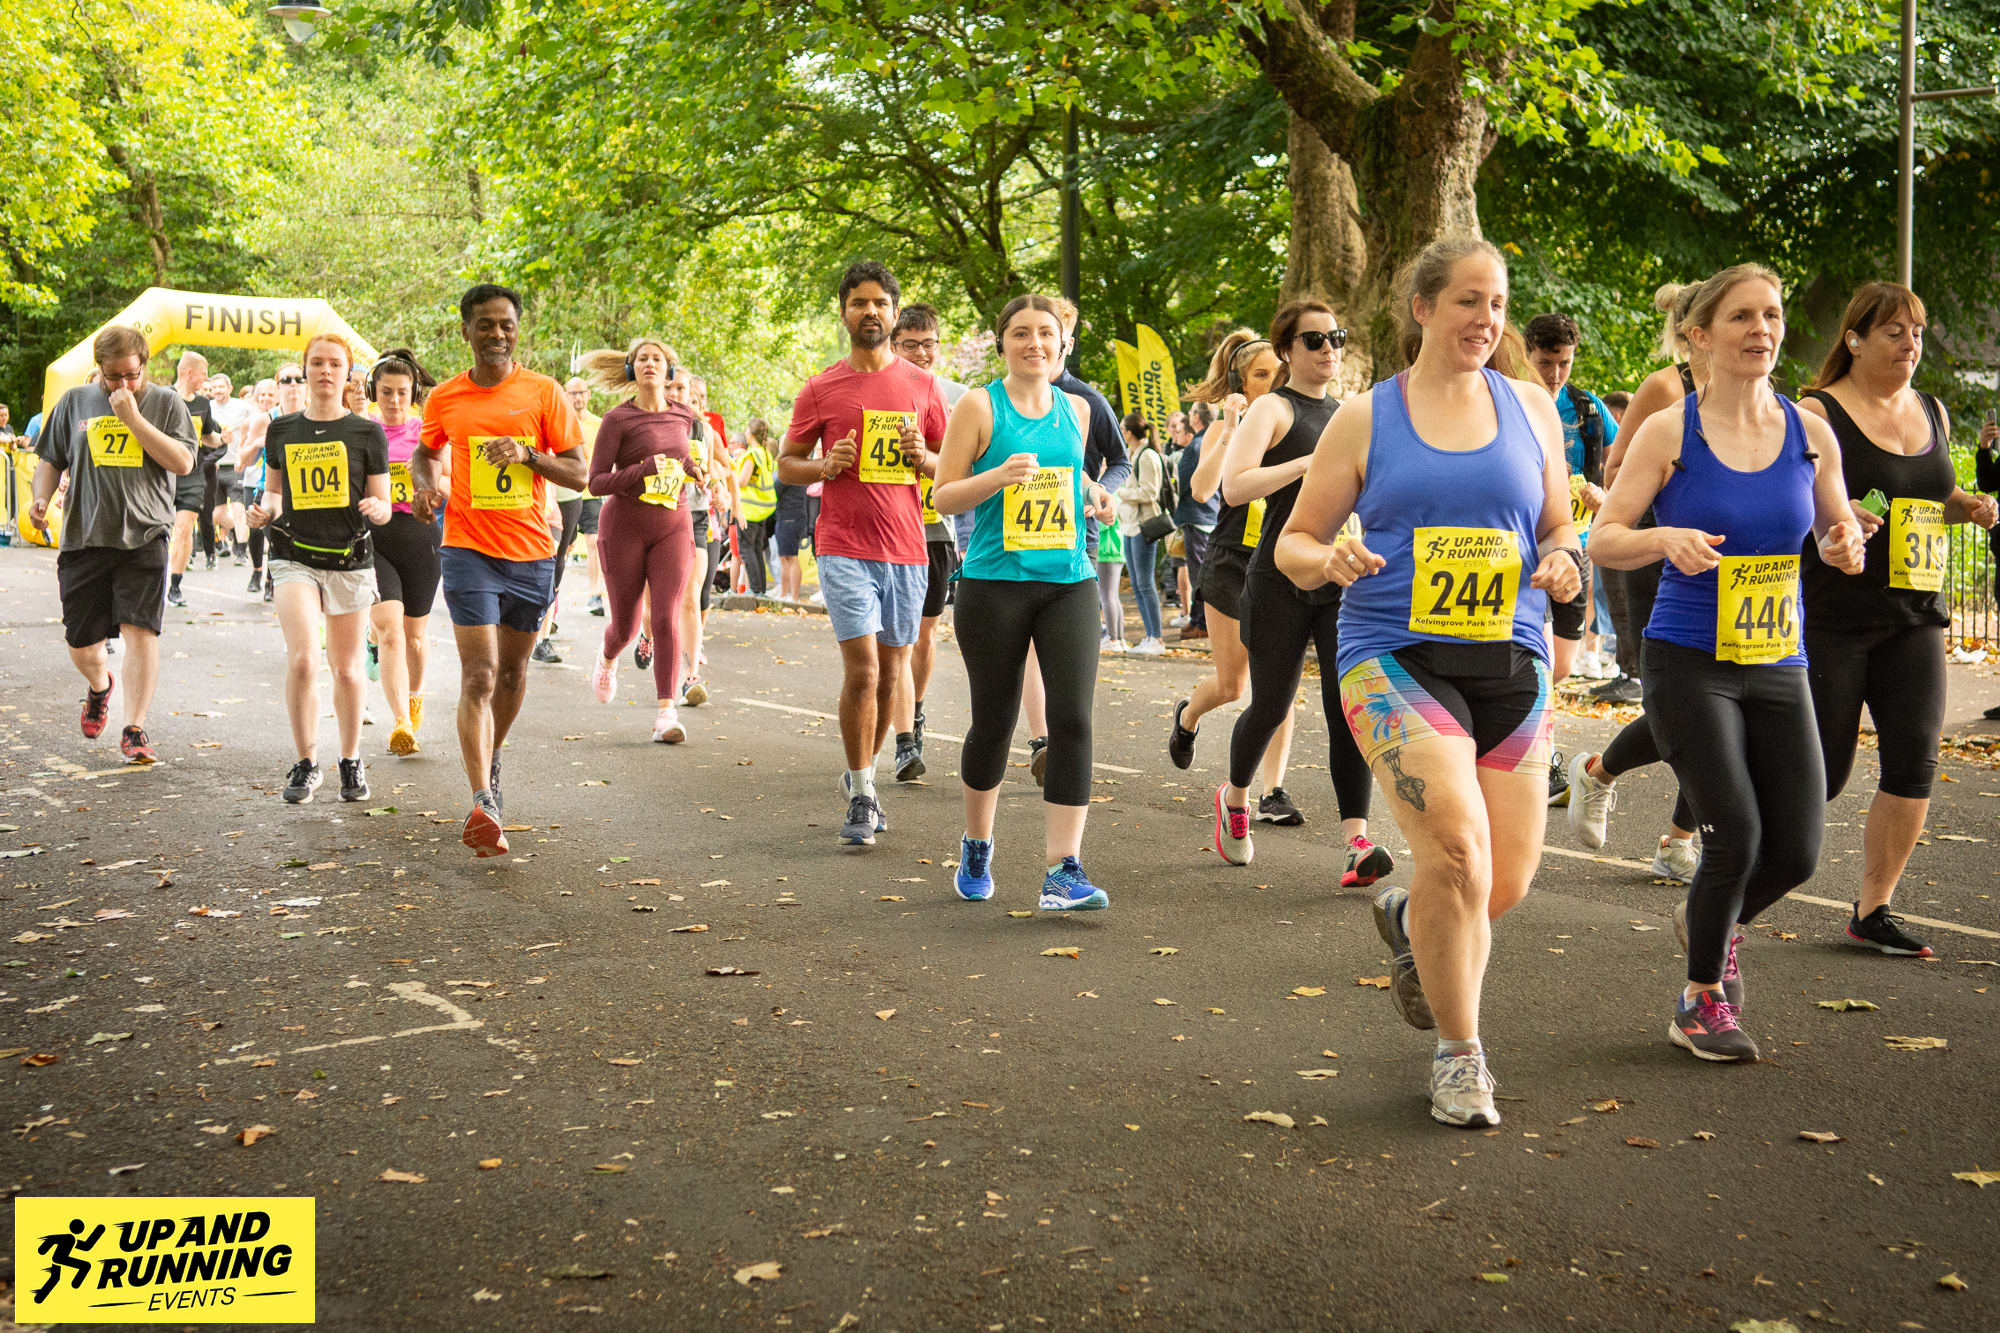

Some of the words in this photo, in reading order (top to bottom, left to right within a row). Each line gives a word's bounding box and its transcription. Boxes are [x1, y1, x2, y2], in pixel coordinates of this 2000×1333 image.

[185, 304, 301, 336] FINISH
[1144, 370, 1154, 409] AND
[103, 433, 129, 454] 27
[307, 446, 318, 454] UP
[319, 444, 335, 452] AND
[303, 450, 340, 461] RUNNING
[300, 466, 340, 493] 104
[496, 465, 512, 493] 6
[1032, 473, 1044, 482] UP
[1045, 471, 1063, 481] AND
[1027, 480, 1068, 491] RUNNING
[921, 486, 935, 510] 6
[1016, 499, 1068, 532] 474
[1919, 506, 1930, 515] UP
[1930, 506, 1944, 515] AN
[1454, 536, 1473, 547] UP
[1473, 536, 1504, 547] AND
[1447, 547, 1509, 559] RUNNING
[1463, 559, 1491, 567] EVENT
[1755, 562, 1770, 573] UP
[1770, 560, 1794, 572] AND
[1749, 570, 1797, 585] RUNNING
[1429, 570, 1505, 617] 244
[1415, 617, 1464, 627] Kelvingrove
[1466, 619, 1486, 627] Park
[1734, 595, 1793, 640] 440
[1721, 641, 1765, 650] Kelvingrove
